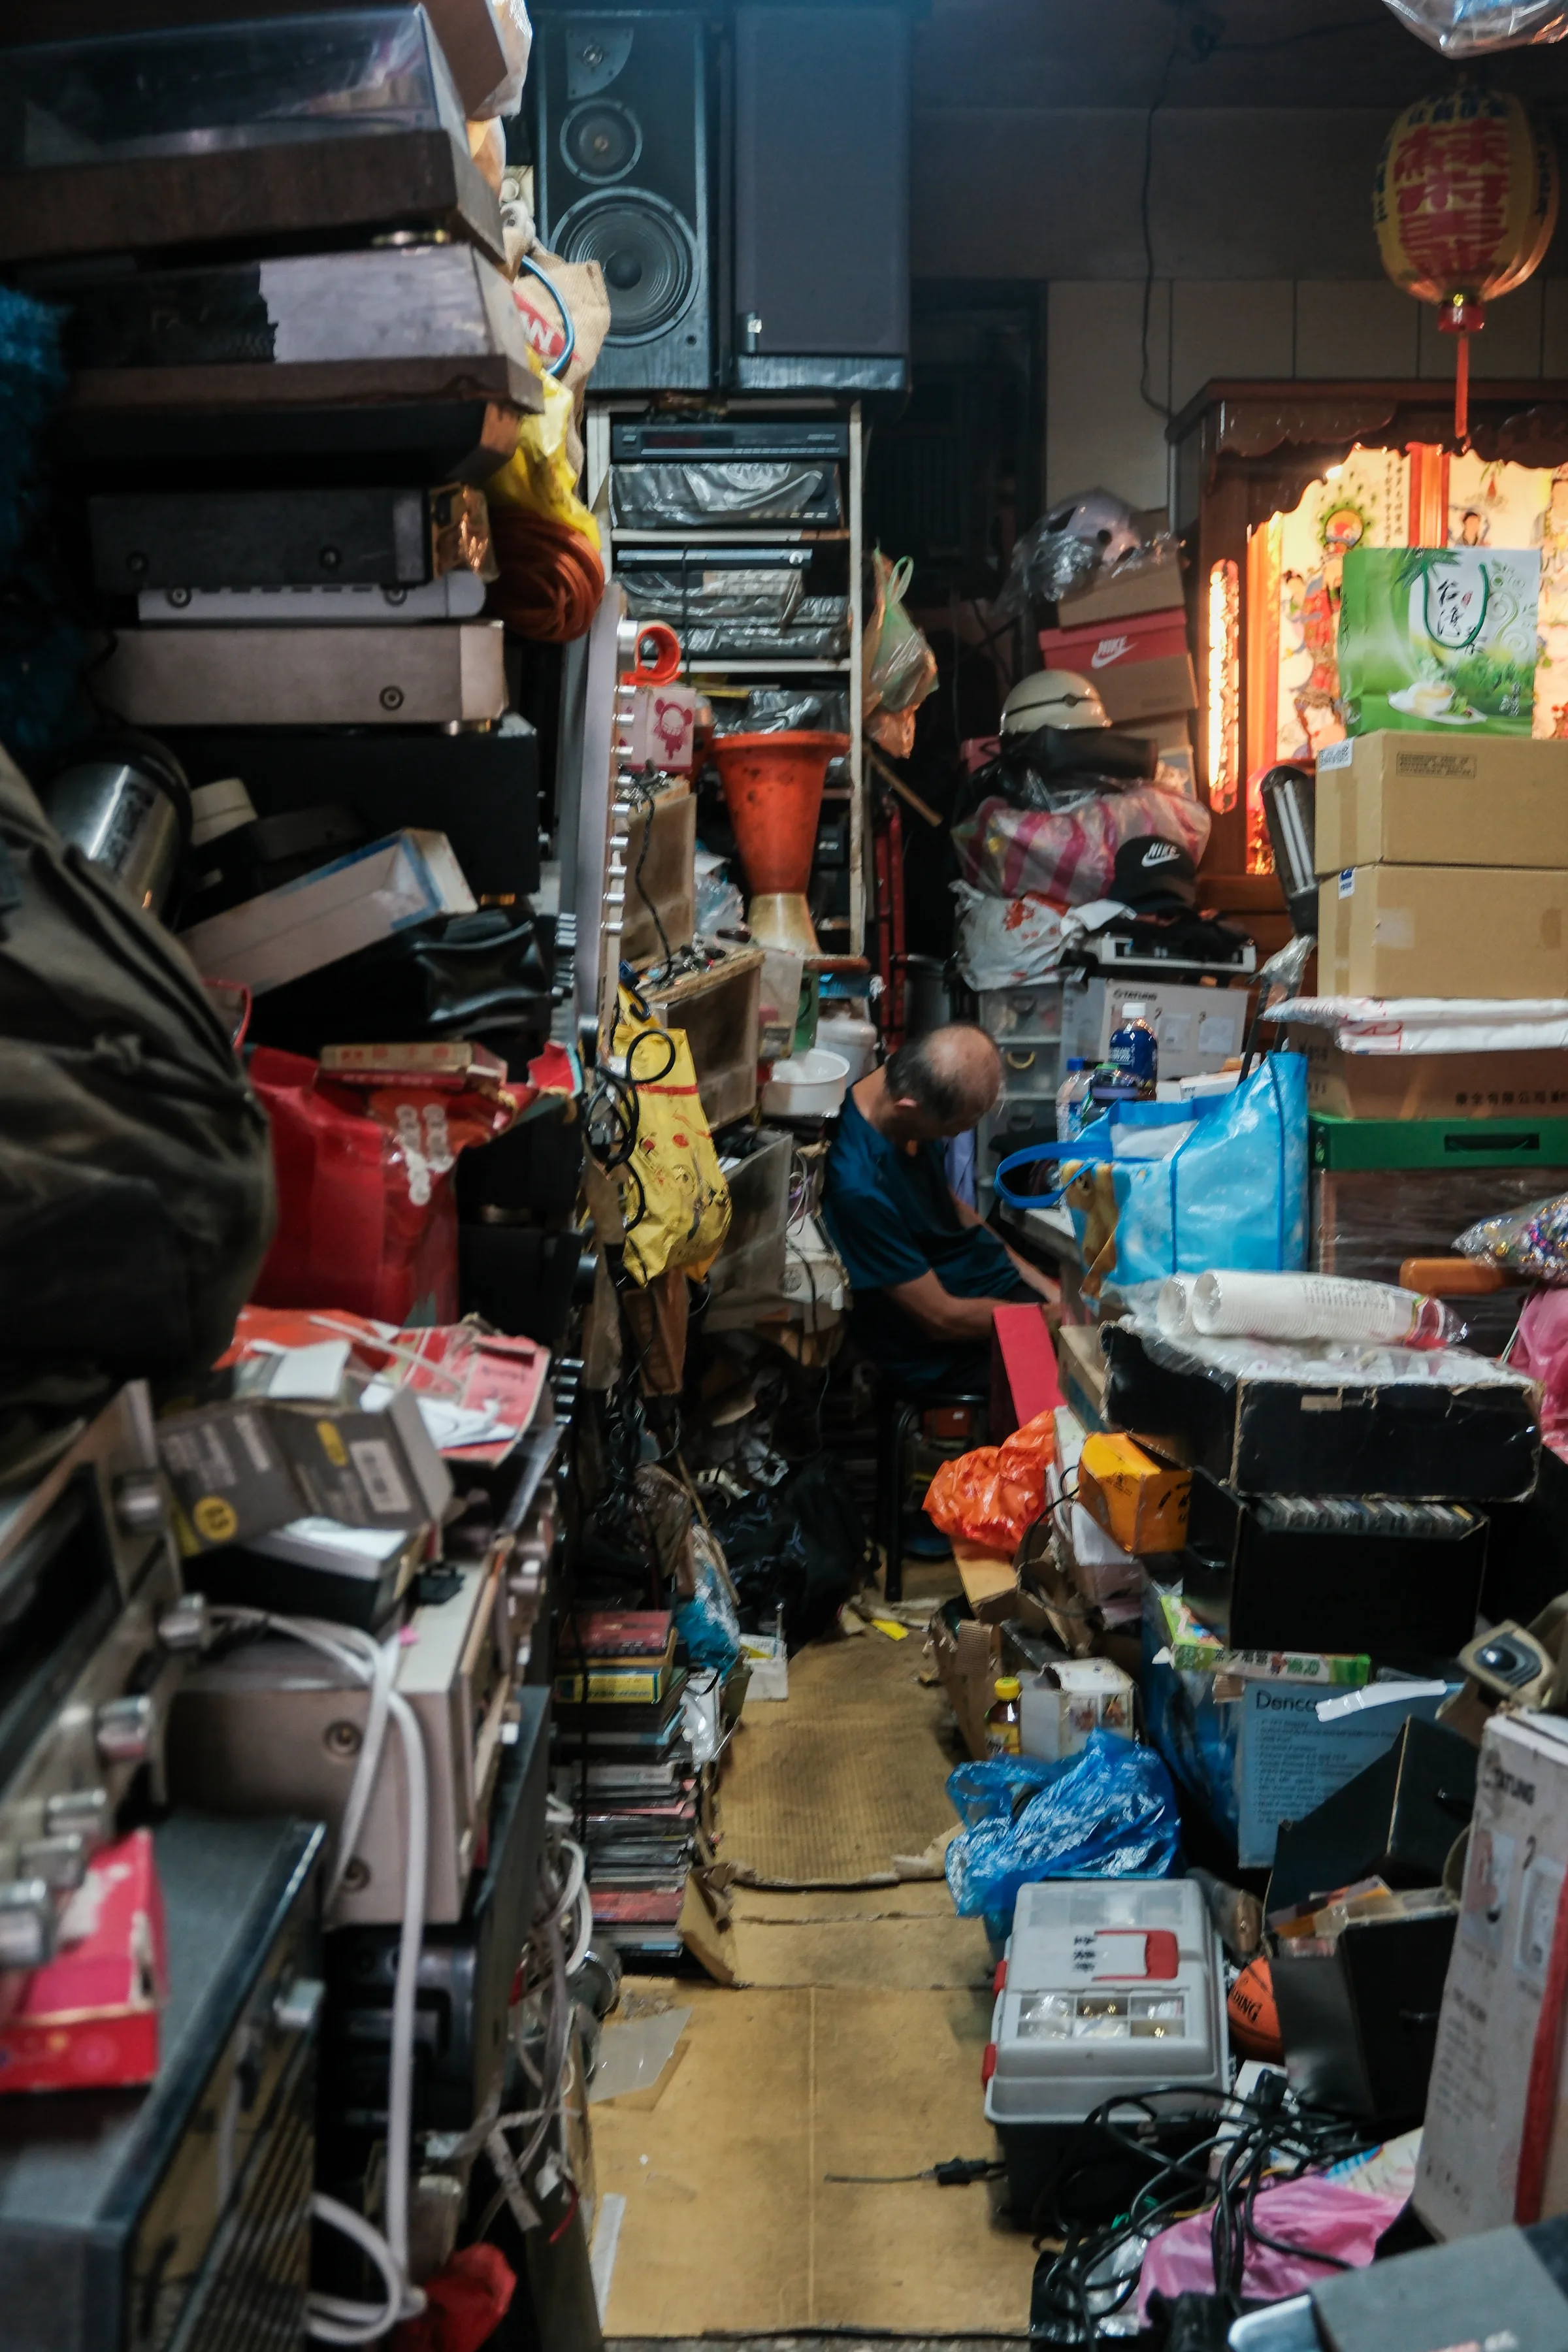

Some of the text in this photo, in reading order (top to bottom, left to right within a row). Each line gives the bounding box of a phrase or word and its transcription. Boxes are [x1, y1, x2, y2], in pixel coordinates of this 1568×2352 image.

[1098, 636, 1128, 656] NIKE
[1148, 842, 1177, 858] NIKE
[1230, 1989, 1263, 2023] DING
